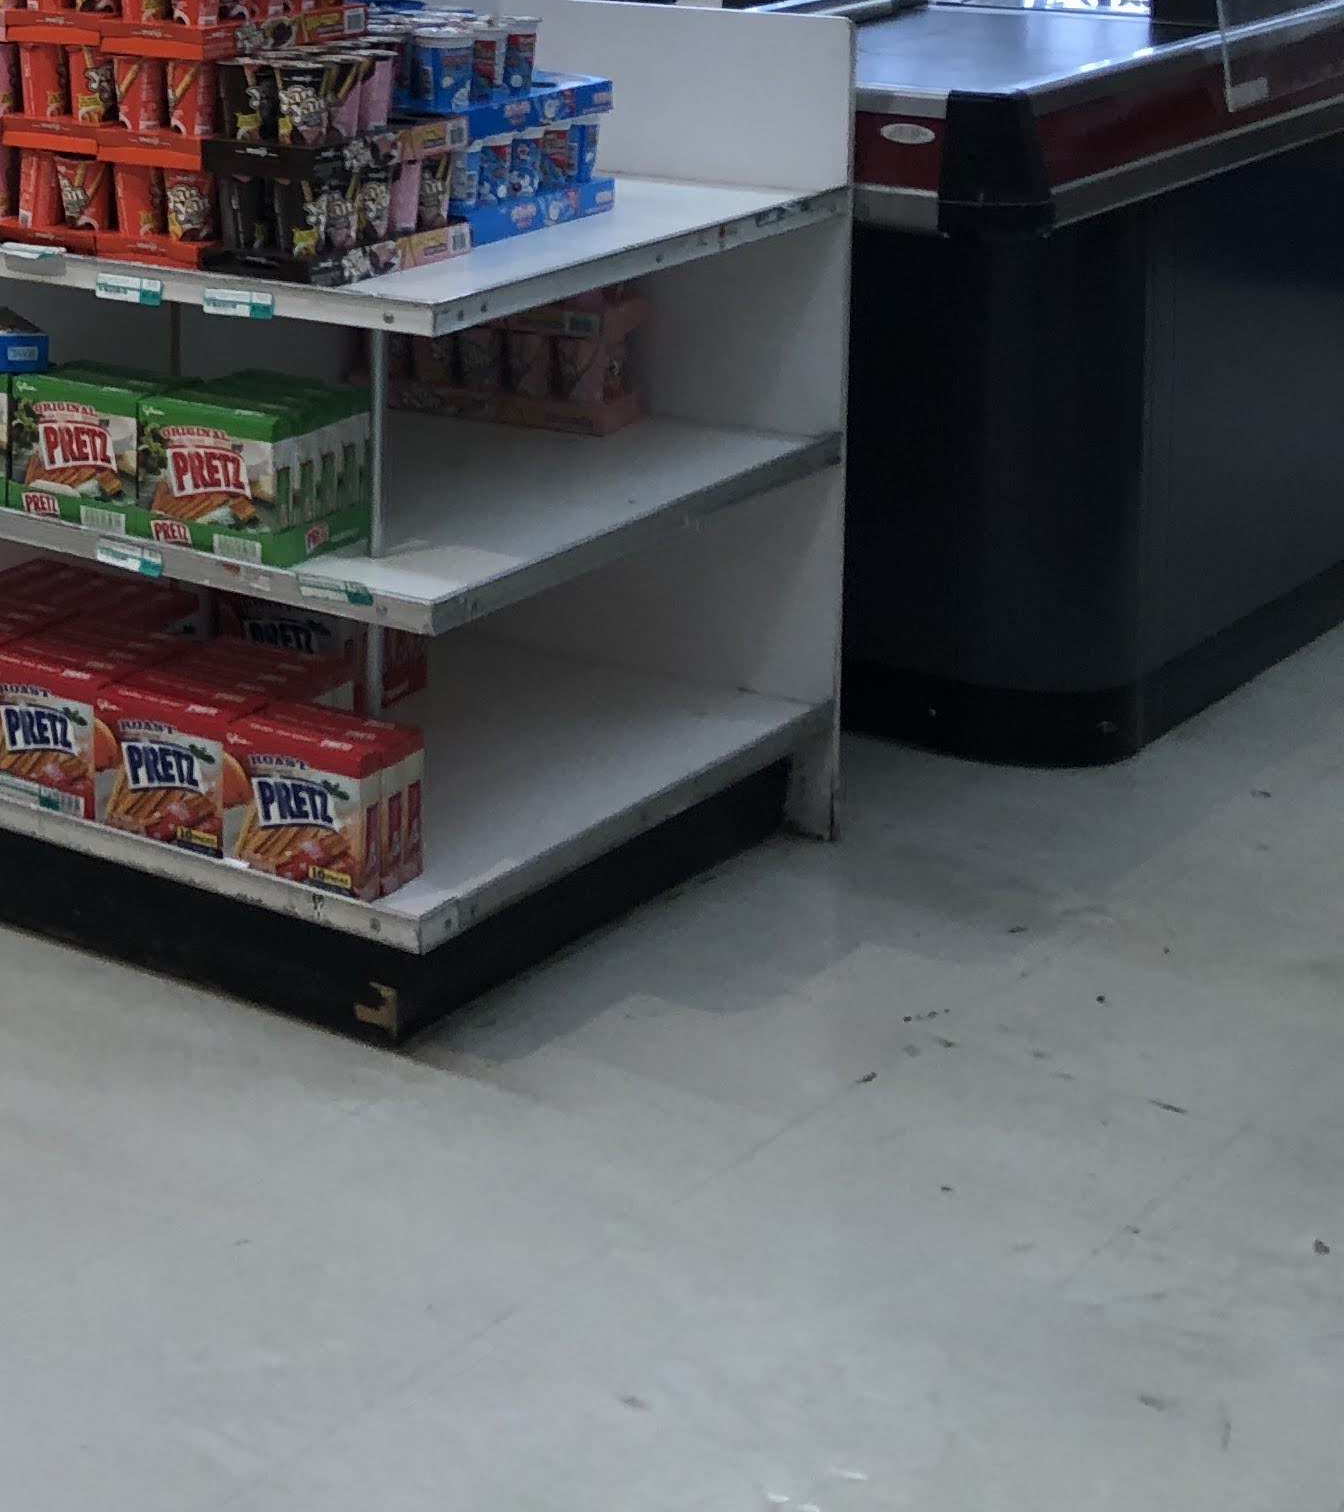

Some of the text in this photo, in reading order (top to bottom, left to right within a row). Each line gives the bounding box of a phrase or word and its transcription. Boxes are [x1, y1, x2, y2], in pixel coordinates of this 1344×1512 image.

[34, 402, 98, 417] ORIGINAL
[160, 426, 231, 441] ORIGINAL
[43, 425, 112, 468] PRETZ
[172, 451, 246, 491] PRETZ
[25, 493, 57, 514] PRETZ
[153, 521, 188, 542] PRETZ
[4, 708, 72, 748] PRETZ
[118, 720, 175, 735] ROAST
[126, 744, 199, 787] PRETZ
[250, 754, 306, 769] ROAST
[256, 781, 335, 825] PRETZ
